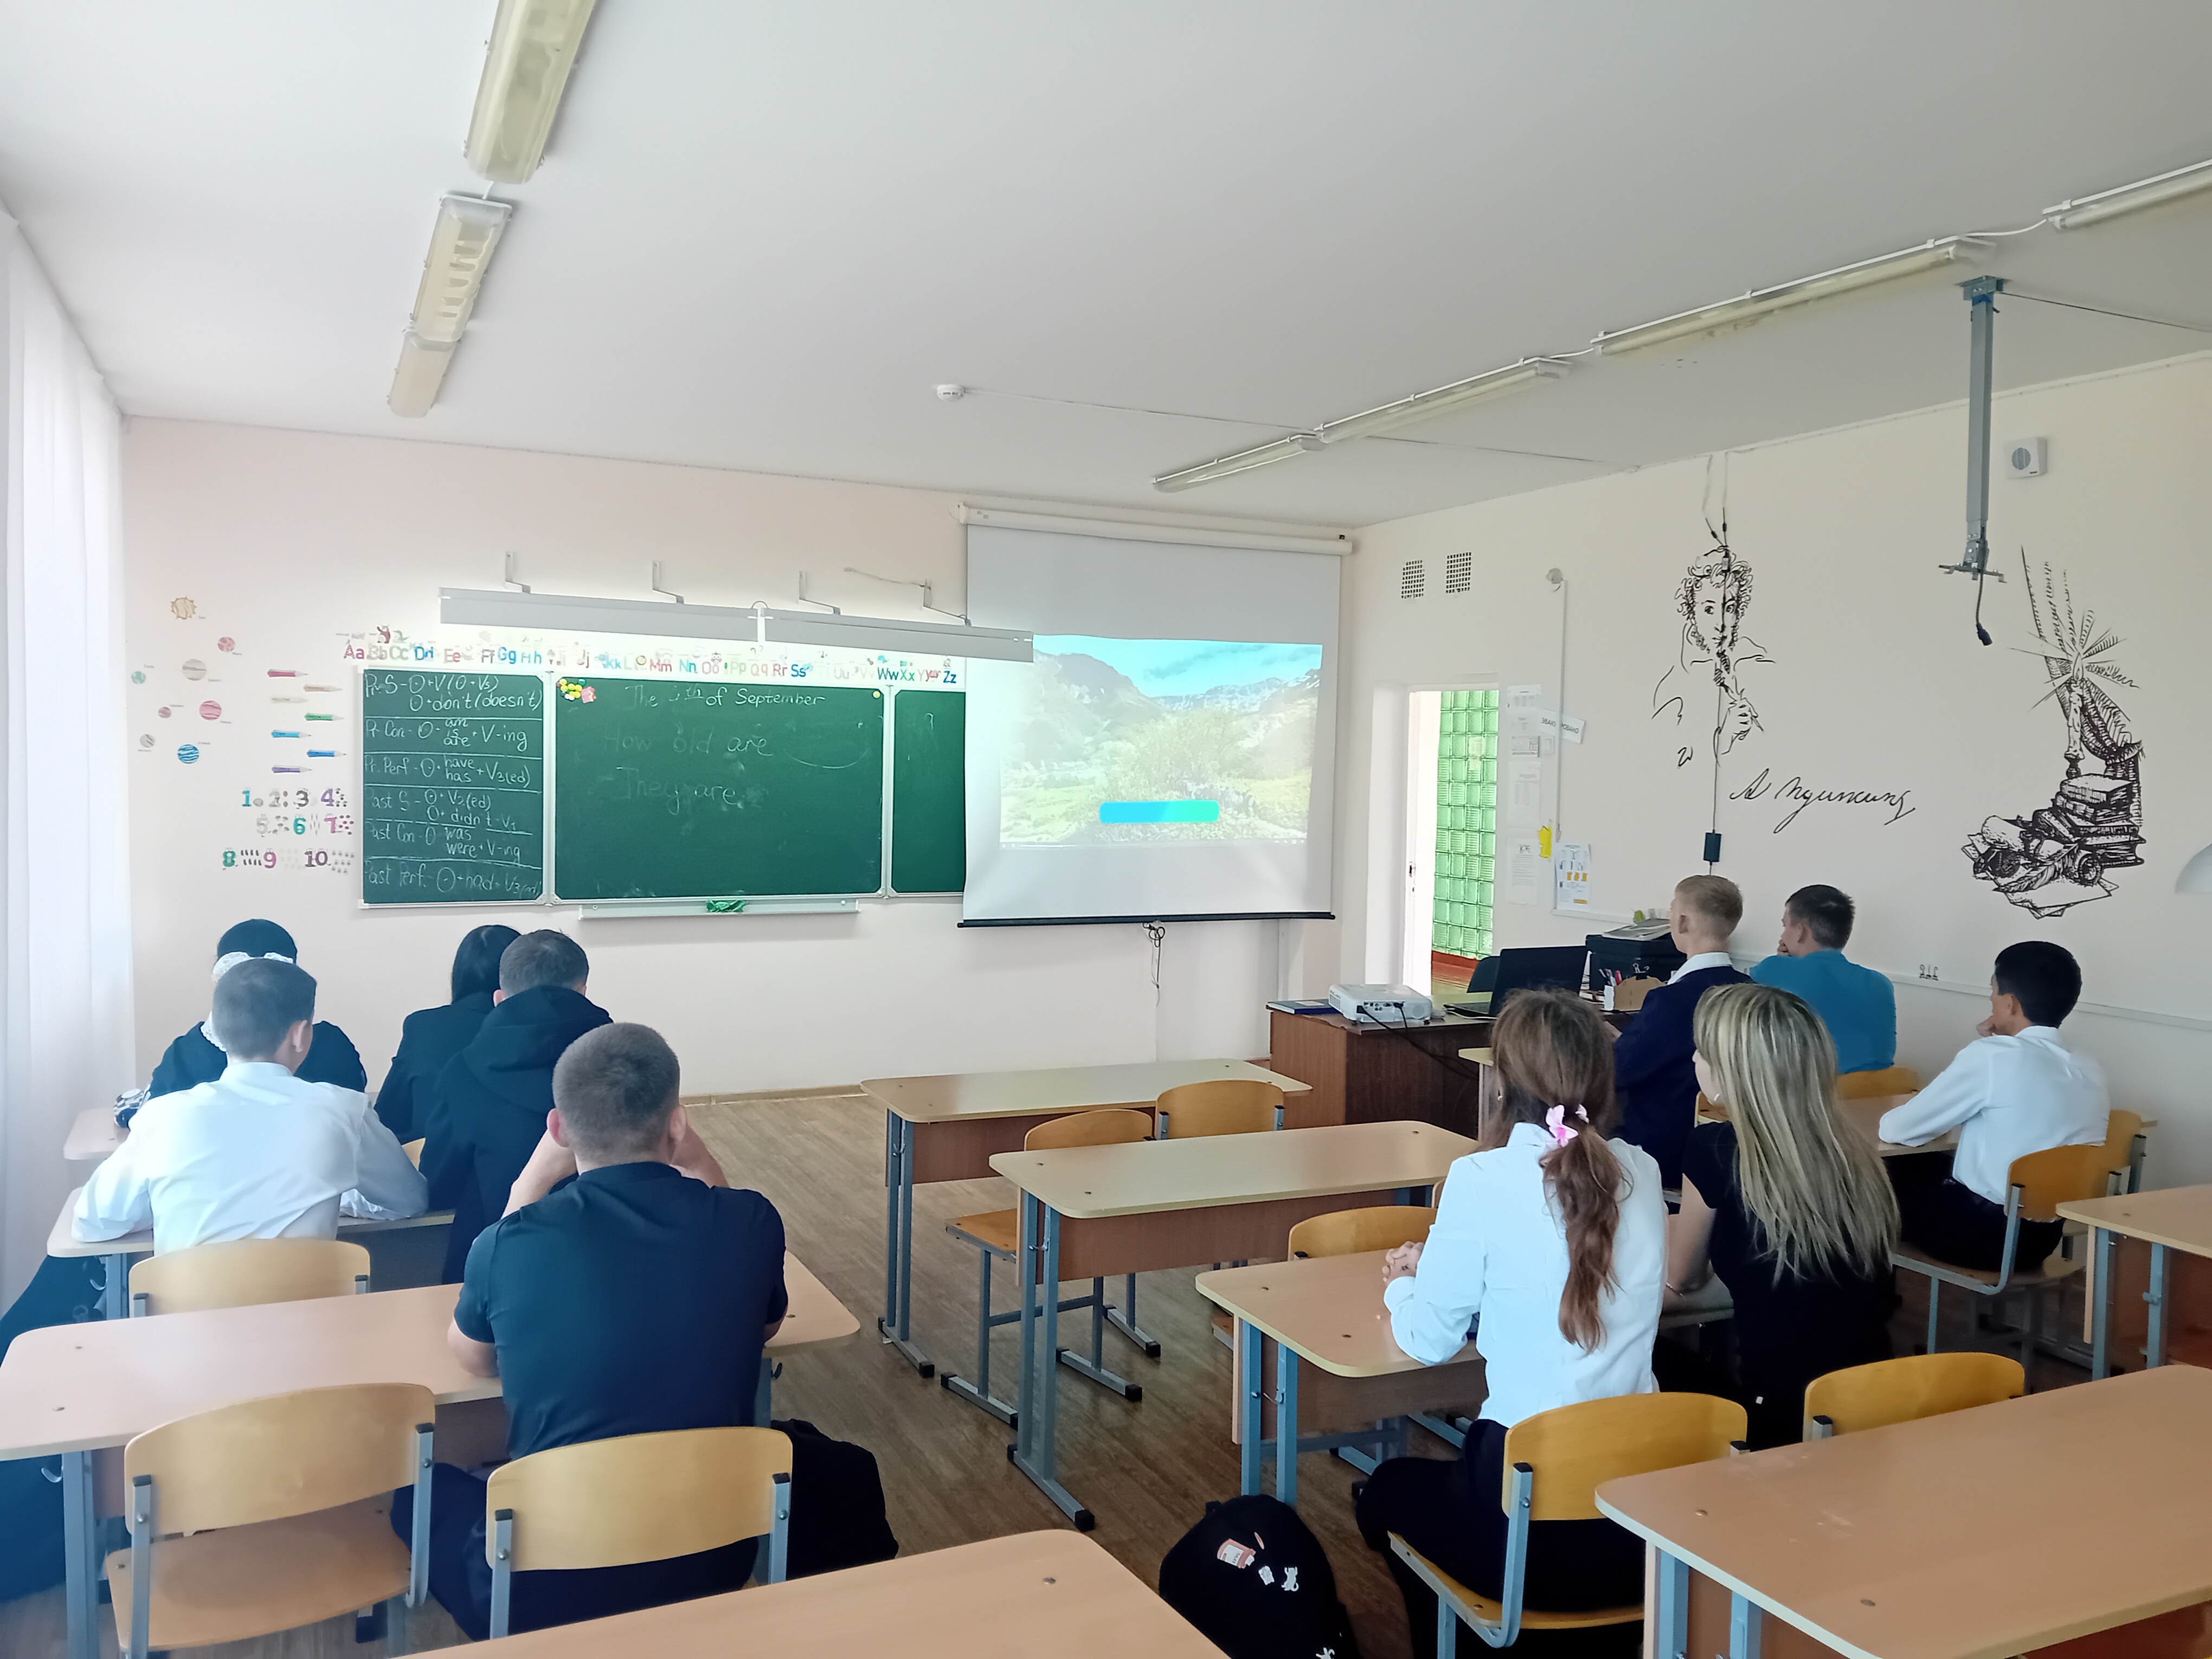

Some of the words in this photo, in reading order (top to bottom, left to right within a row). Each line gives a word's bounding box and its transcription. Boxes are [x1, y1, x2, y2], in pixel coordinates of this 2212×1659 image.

[344, 644, 364, 659] Aa
[389, 645, 409, 660] Cc
[443, 648, 461, 663] Ee
[497, 647, 517, 664] Gg
[650, 658, 672, 672] Mm
[679, 659, 697, 673] Nn
[702, 660, 719, 674] Oo
[750, 663, 768, 677] Qq
[773, 664, 787, 677] Rr
[791, 664, 807, 678] Ss
[877, 667, 899, 681] Ww
[900, 669, 915, 681] Xx
[943, 671, 956, 684] Zz
[625, 685, 658, 707] The
[706, 686, 728, 706] of
[735, 685, 826, 708] September
[445, 718, 468, 727] am
[443, 737, 470, 747] are
[604, 722, 652, 754] How
[673, 726, 714, 754] old
[727, 736, 773, 756] are
[384, 757, 409, 775] Perf
[444, 754, 475, 769] have
[446, 769, 472, 782] has
[242, 790, 251, 807] 1
[268, 791, 281, 807] 2
[295, 790, 309, 807] 3
[320, 789, 335, 807] 4
[617, 766, 679, 815] They
[256, 818, 268, 834] 5
[293, 818, 306, 835] 6
[324, 817, 337, 833] 7
[445, 827, 472, 840] was
[446, 842, 478, 858] were
[222, 850, 235, 867] 8
[263, 851, 276, 869] 9
[304, 851, 328, 867] 10
[465, 875, 494, 891] had
